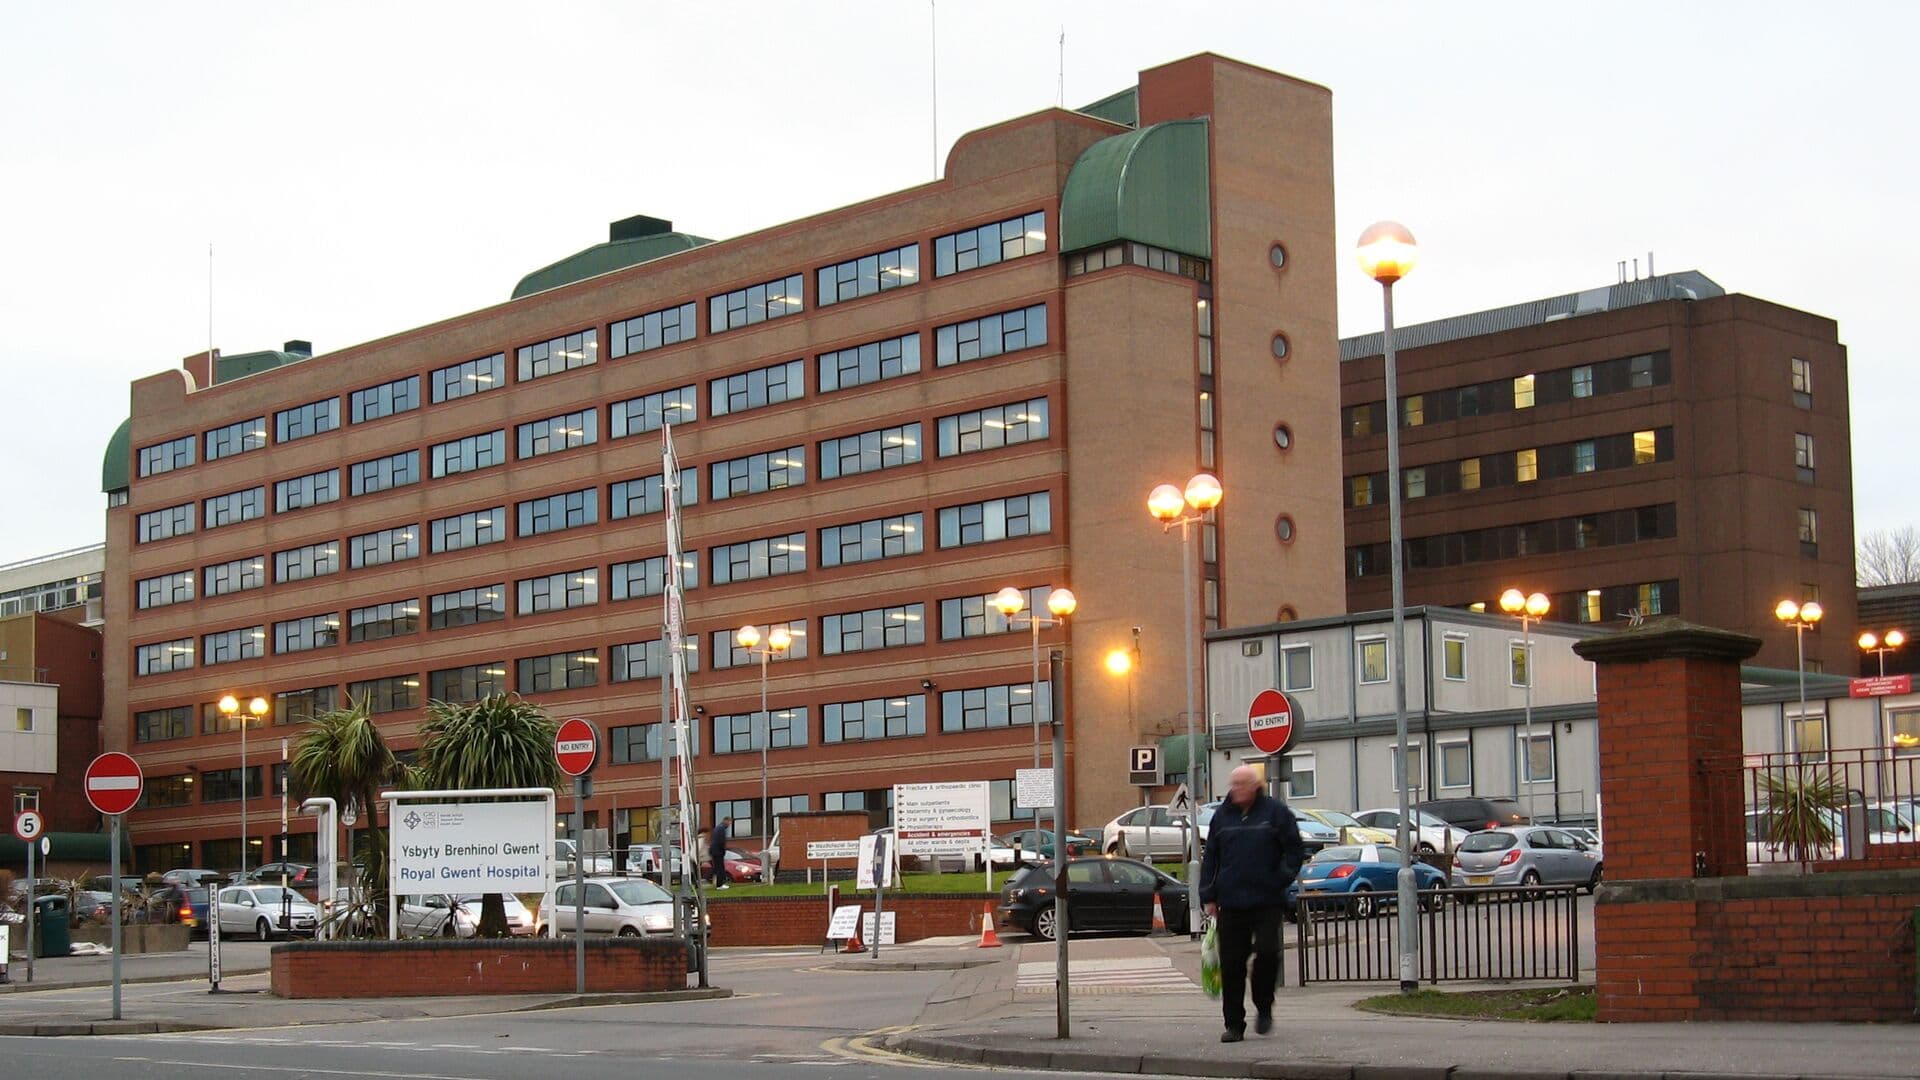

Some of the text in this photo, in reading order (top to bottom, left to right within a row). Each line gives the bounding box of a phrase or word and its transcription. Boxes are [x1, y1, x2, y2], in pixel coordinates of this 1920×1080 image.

[1265, 716, 1285, 725] ENTRY
[571, 743, 589, 751] ENTRY
[1137, 749, 1152, 770] P
[23, 818, 34, 833] 5
[402, 842, 540, 859] Ysbyty Brenhinol Gwent
[401, 865, 540, 881] Royal Gwent Hospital
